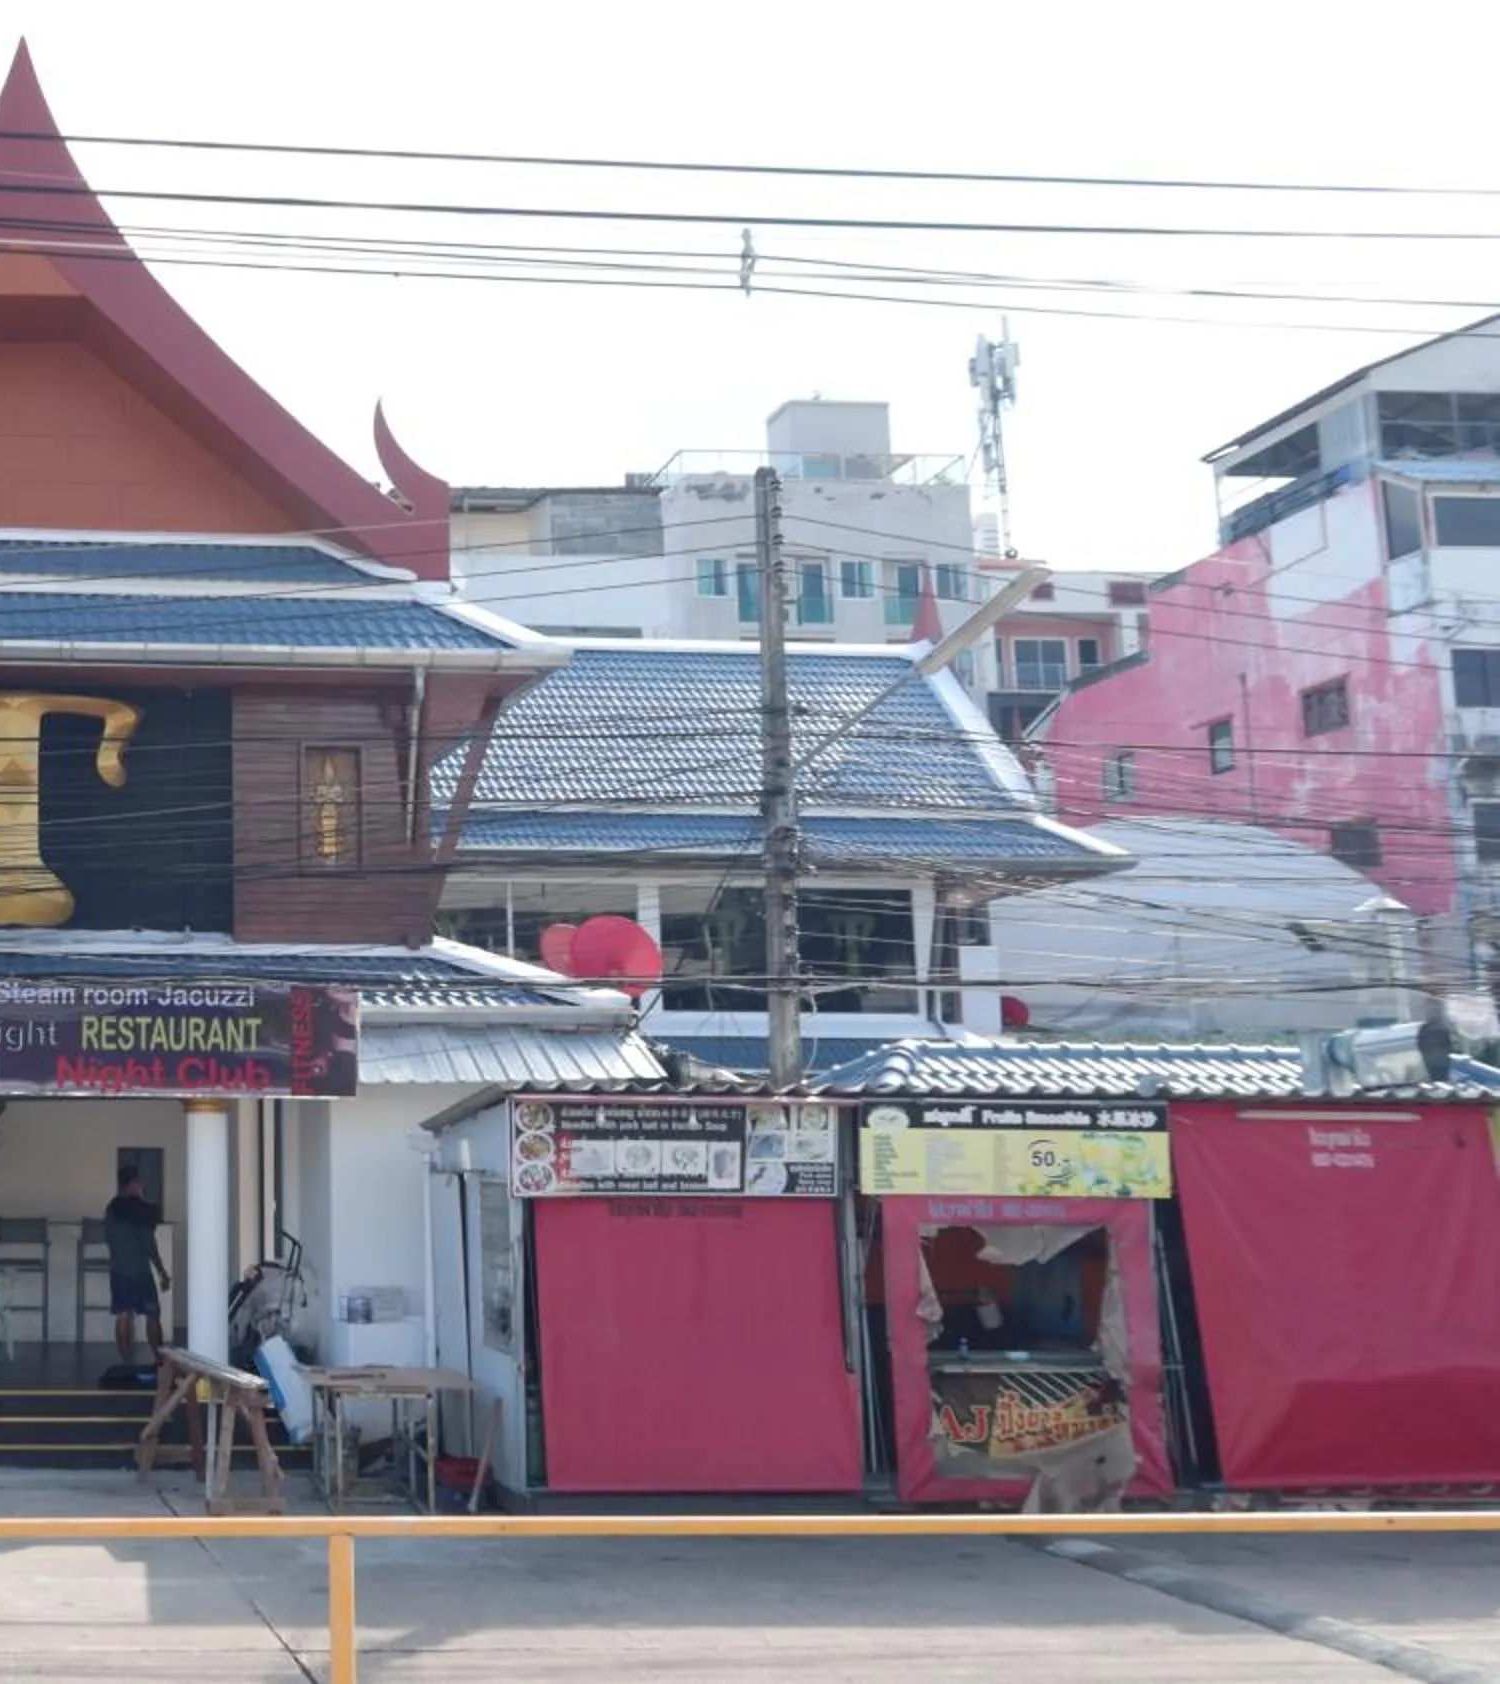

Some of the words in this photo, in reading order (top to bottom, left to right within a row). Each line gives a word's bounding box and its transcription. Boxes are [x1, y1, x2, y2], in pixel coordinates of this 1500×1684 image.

[83, 983, 148, 1005] room
[157, 984, 254, 1007] Jacuzzi
[80, 1016, 262, 1051] RESTAURANT
[56, 1056, 164, 1093] Night
[177, 1056, 270, 1089] Club
